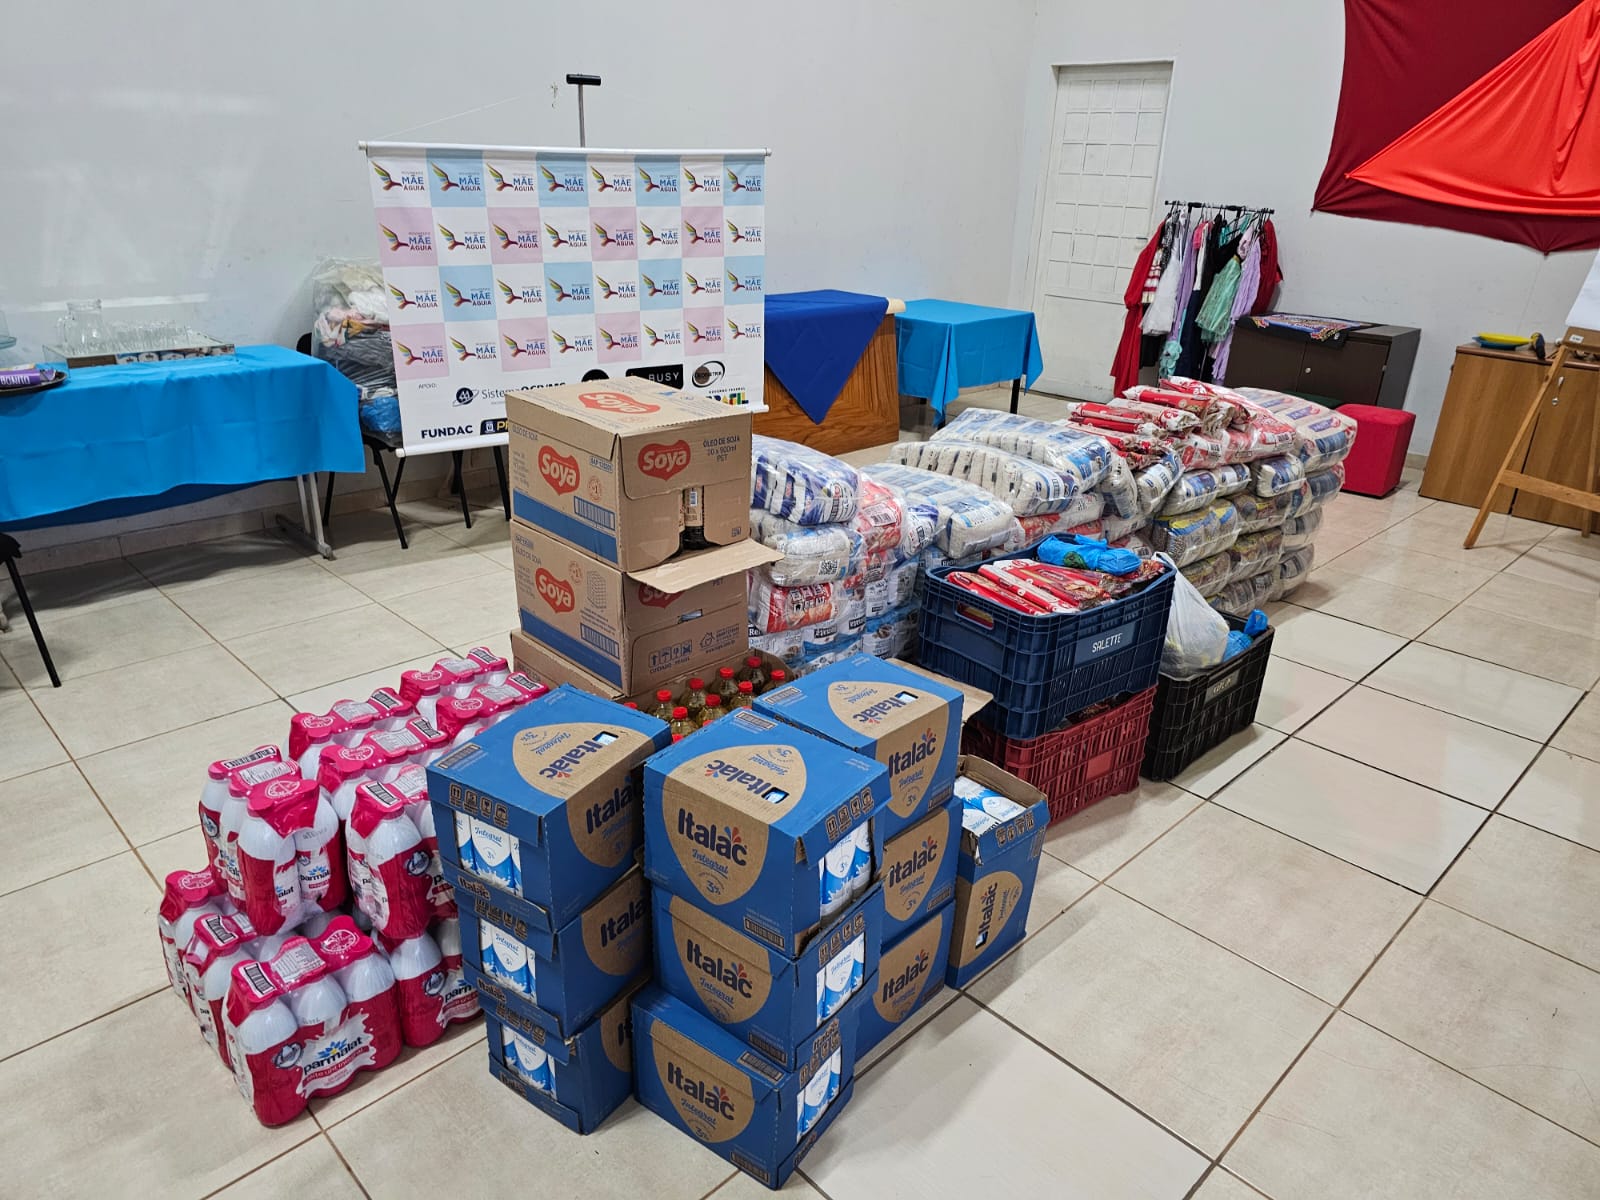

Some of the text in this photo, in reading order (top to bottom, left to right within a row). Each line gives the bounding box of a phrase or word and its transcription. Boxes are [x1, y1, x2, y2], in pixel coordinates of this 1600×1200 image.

[401, 175, 424, 185] MÃE
[458, 175, 480, 185] MÃE
[513, 176, 534, 186] MÃE
[564, 176, 584, 186] MÃE
[408, 234, 432, 244] MÃE
[464, 233, 485, 244] MÃE
[517, 233, 538, 243] MÃE
[568, 232, 587, 242] MÃE
[415, 292, 437, 303] MÃE
[471, 290, 490, 301] MÃE
[522, 288, 542, 298] MÃE
[571, 286, 590, 296] MÃE
[475, 344, 496, 354] MÃE
[526, 340, 545, 351] MÃE
[574, 338, 593, 348] MÃE
[422, 347, 443, 358] MÃE
[648, 372, 680, 383] BUSY
[421, 425, 473, 439] FUNDAC
[643, 450, 687, 472] Soya
[541, 453, 577, 487] Soya
[539, 574, 572, 606] Soya
[1091, 633, 1123, 653] SALETTE
[852, 696, 907, 723] Italac
[539, 740, 603, 778] Italac
[888, 737, 937, 778] Italac
[707, 760, 772, 795] Italac
[586, 785, 633, 835] Itala
[474, 826, 502, 843] Integral
[678, 808, 747, 866] Italac
[692, 848, 729, 874] Integral
[889, 844, 938, 888] Italac
[978, 882, 998, 935] Italac
[600, 899, 648, 947] Itala
[686, 938, 753, 998] Italac
[882, 956, 929, 1003] Italac
[303, 1037, 363, 1075] parmalat
[667, 1062, 735, 1120] Italac
